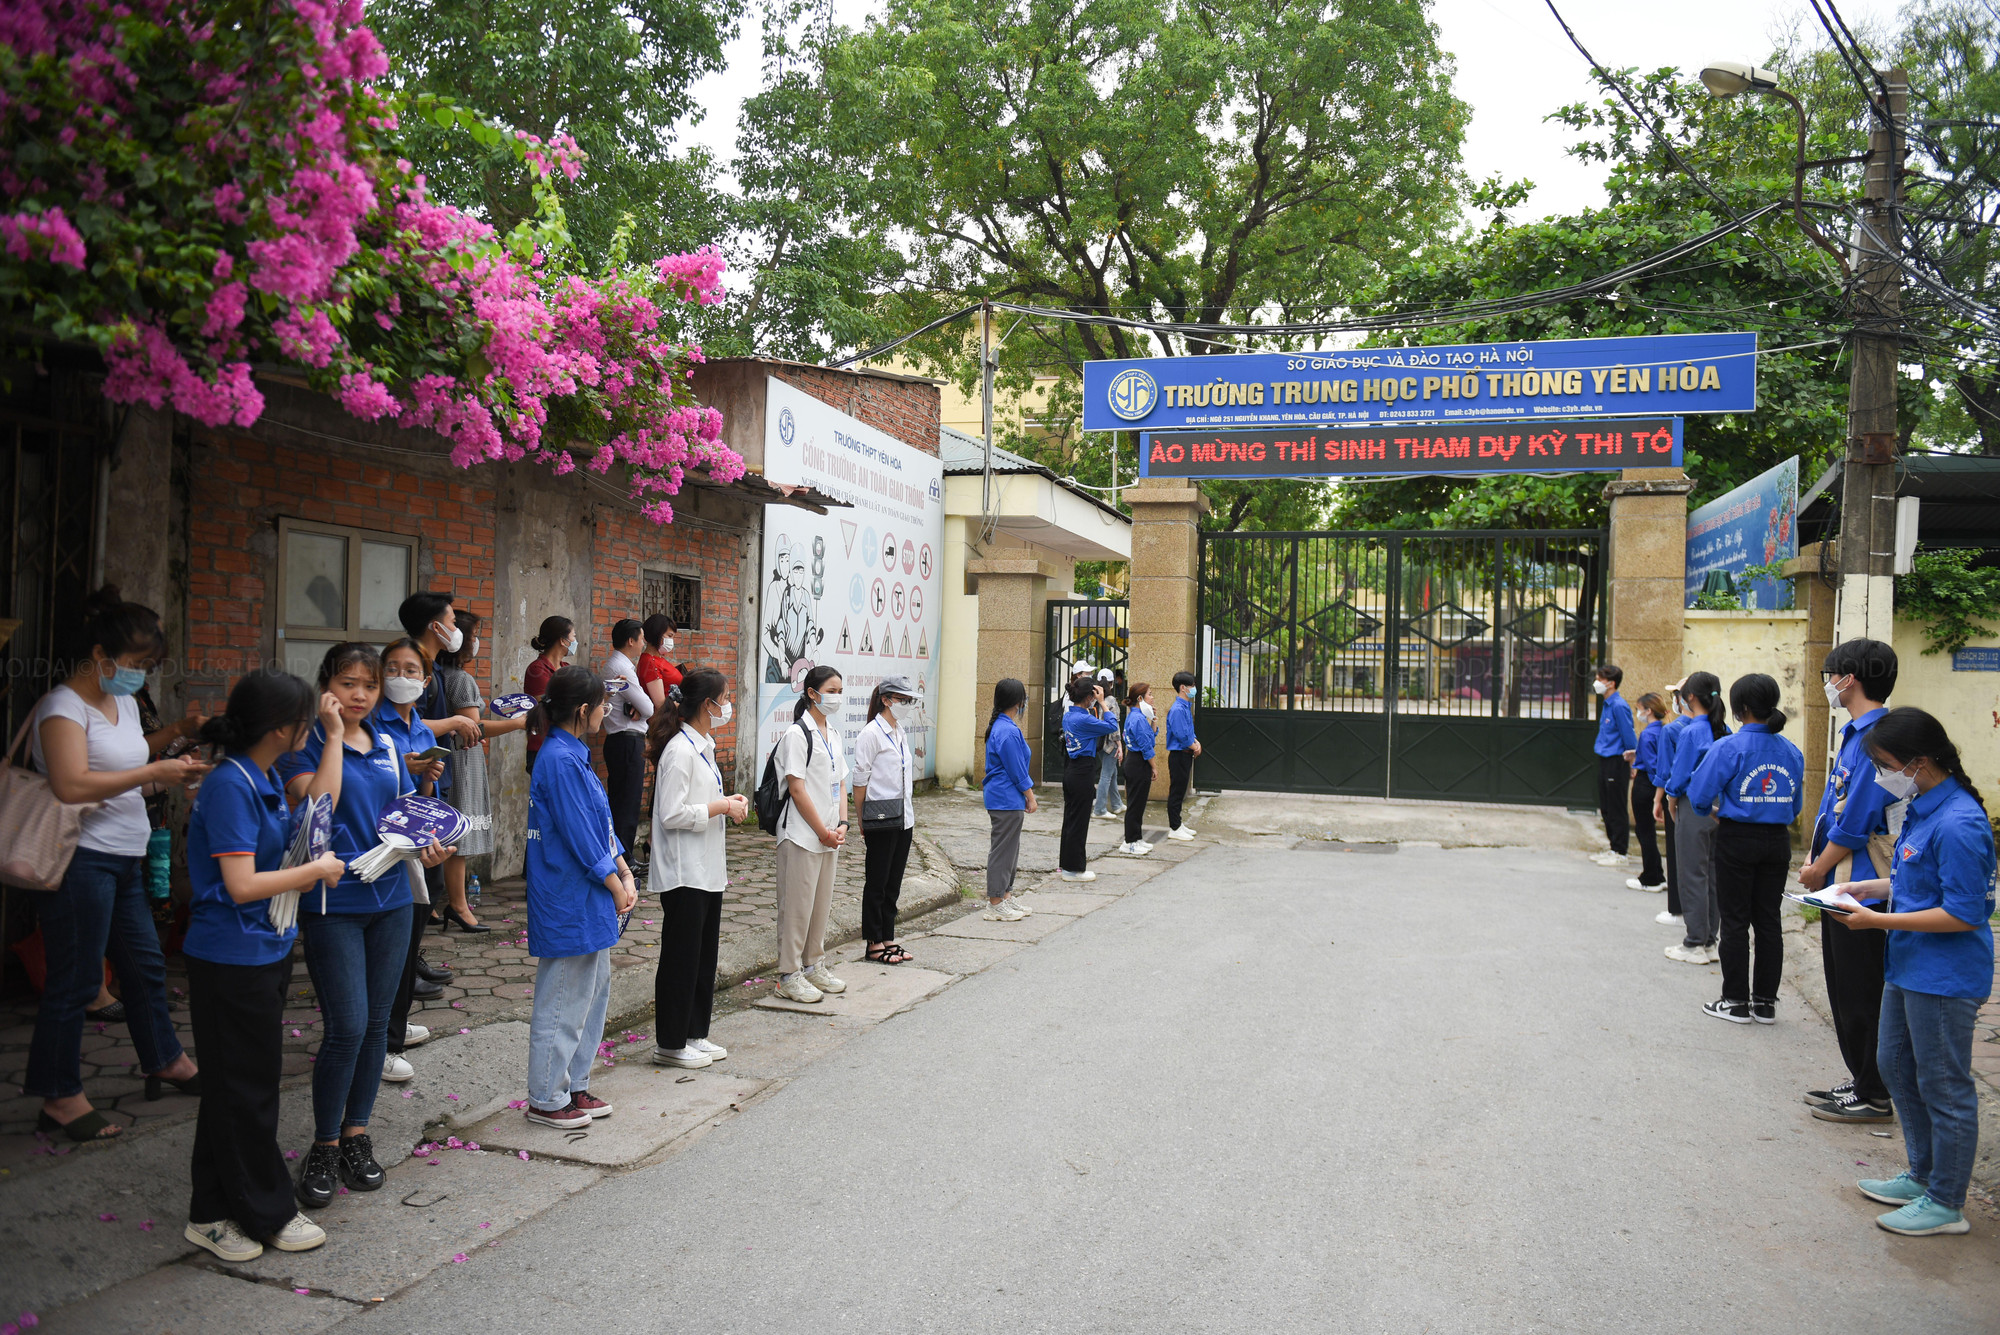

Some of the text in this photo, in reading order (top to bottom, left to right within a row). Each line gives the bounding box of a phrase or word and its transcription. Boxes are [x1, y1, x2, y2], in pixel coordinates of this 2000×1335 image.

[1287, 347, 1532, 373] SỞ GIÁO DỤC VÀ ĐÀO TẠO HÀ NỘI
[1163, 361, 1721, 408] TRƯỜNG TRUNG HỌC PHỔ THÔNG YÊN HÒA
[1259, 414, 1280, 422] KHANG,
[1282, 412, 1293, 420] YÊN
[1309, 411, 1321, 420] CẦU
[1348, 410, 1358, 419] HÀ
[1358, 410, 1369, 420] NỘI
[1390, 410, 1406, 418] 0243
[1420, 409, 1435, 417] 3721
[1444, 408, 1463, 416] Email:
[1533, 406, 1561, 414] Website:
[862, 443, 878, 460] THPT
[878, 449, 889, 466] YÊN
[1191, 438, 1266, 463] MỪNG
[1274, 436, 1316, 461] THÍ
[1324, 439, 1385, 461] SINH
[1393, 437, 1471, 460] THAM
[1478, 435, 1521, 461] DỰ
[1528, 429, 1568, 456] KỲ
[1575, 432, 1622, 455] THI
[802, 436, 925, 510] CỔNG TRƯỜNG AN TOÀN GIAO THÔNG
